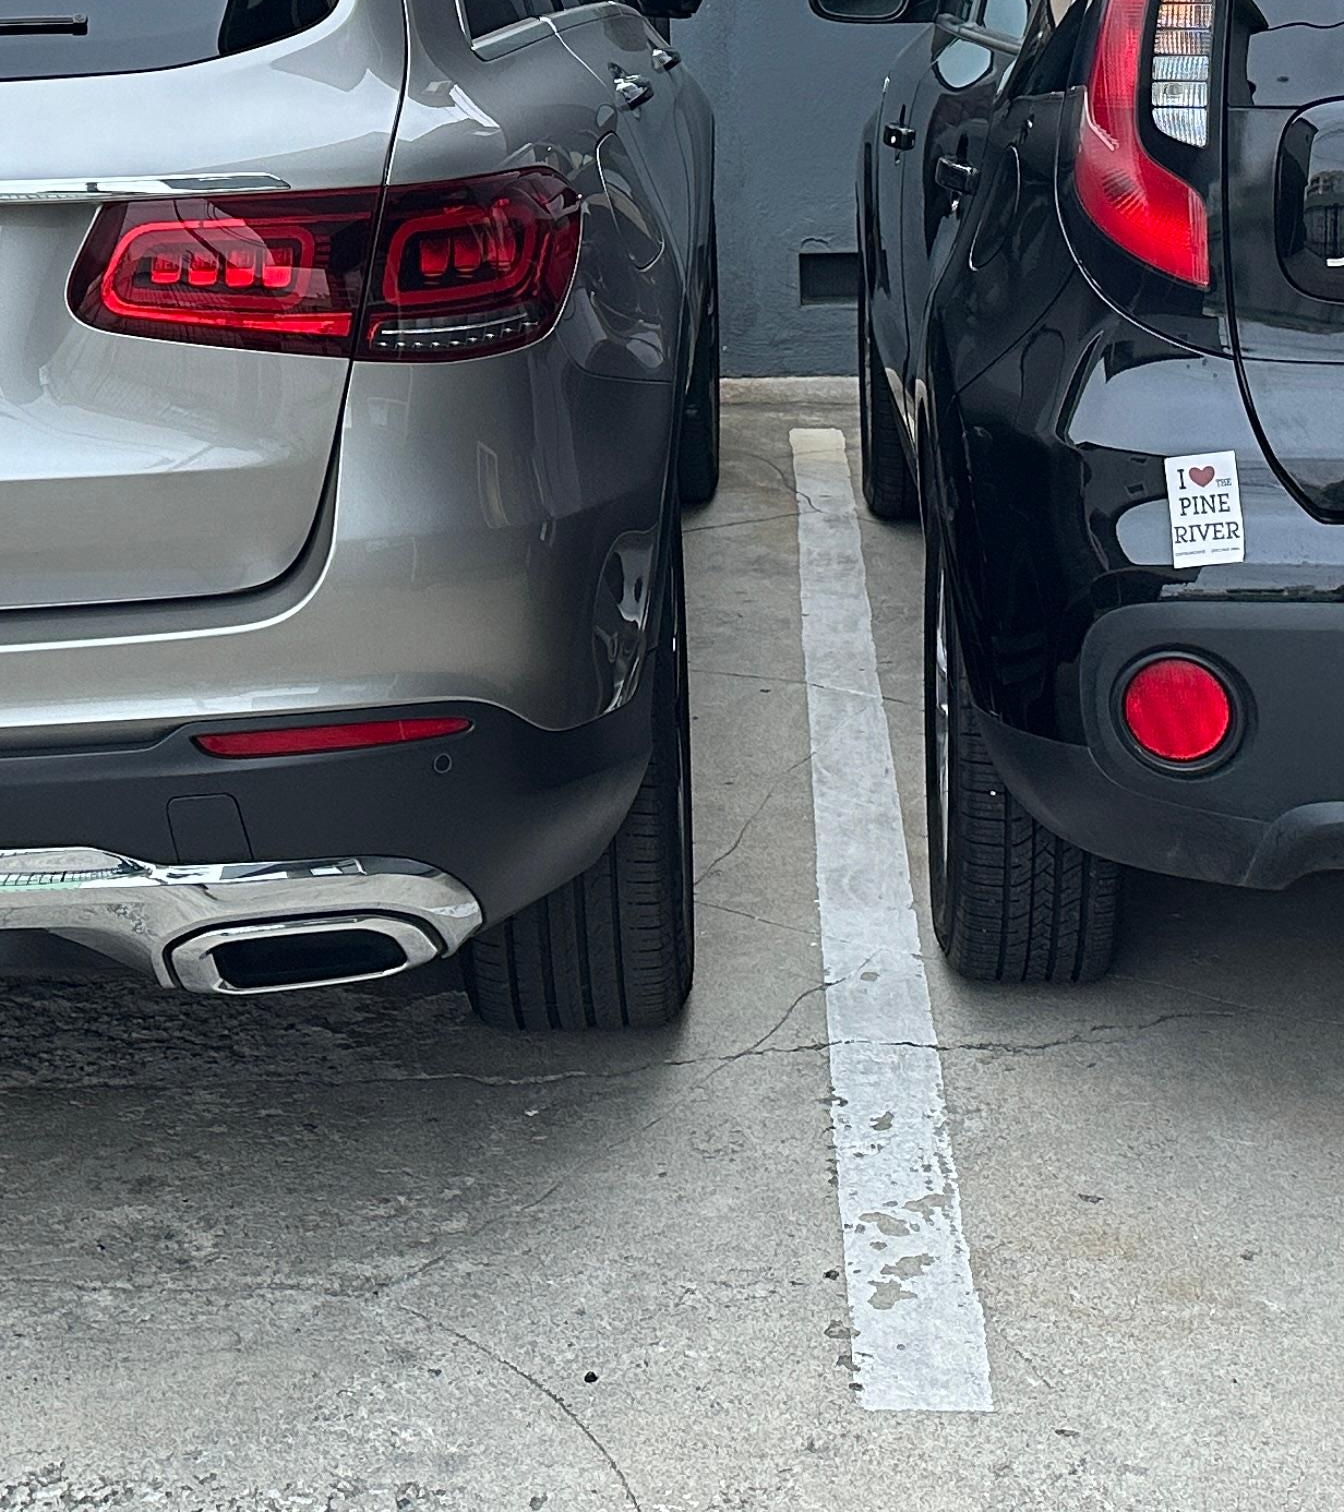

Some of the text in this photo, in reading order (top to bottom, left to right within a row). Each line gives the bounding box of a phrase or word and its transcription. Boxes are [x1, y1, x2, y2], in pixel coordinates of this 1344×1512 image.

[1177, 468, 1232, 490] I THE
[1178, 493, 1231, 516] PINE
[1173, 521, 1241, 544] RIVER
